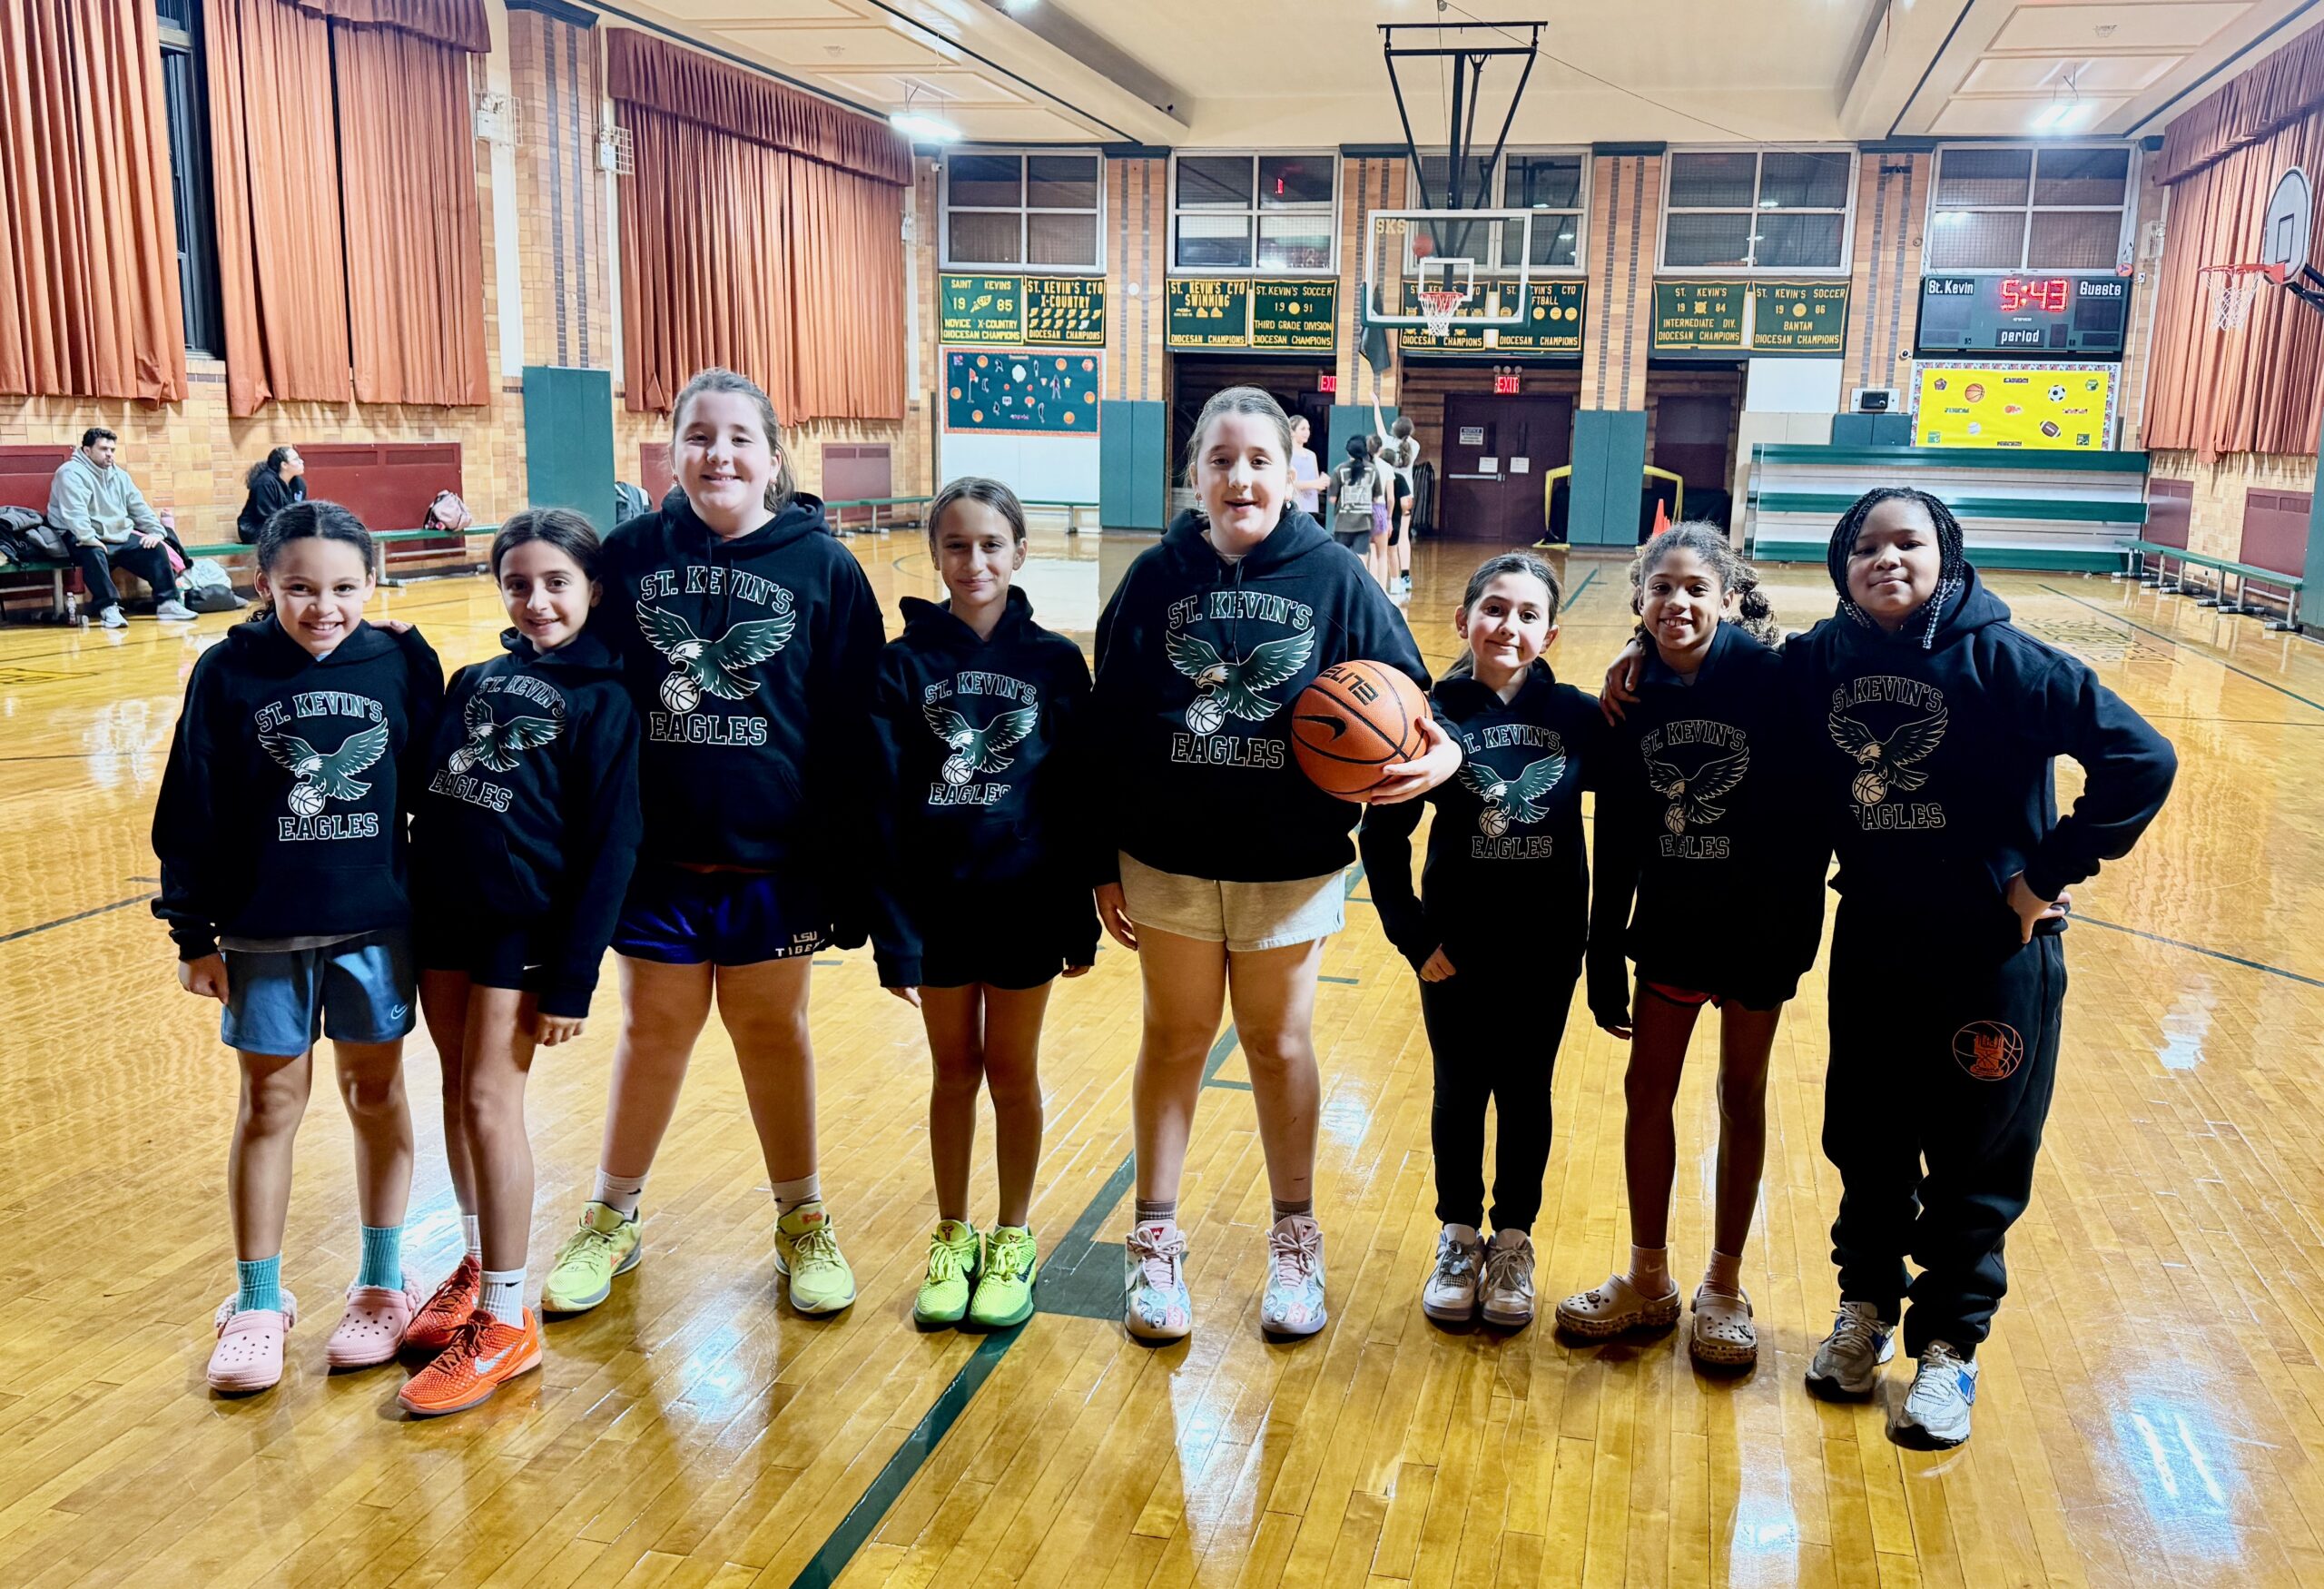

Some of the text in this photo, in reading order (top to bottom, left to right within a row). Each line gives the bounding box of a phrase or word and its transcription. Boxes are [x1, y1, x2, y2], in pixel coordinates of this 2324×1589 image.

[1375, 218, 1406, 234] SKS
[950, 279, 1012, 291] SAINT KEVINS
[1028, 281, 1103, 294] ST. KEVIN'S CYO
[1170, 281, 1245, 295] ST. KEVIN'S CYO
[1302, 286, 1332, 296] SOCCER
[1410, 284, 1419, 294] ST
[1506, 285, 1516, 295] ST.
[1561, 285, 1576, 295] CYO
[1675, 287, 1728, 297] ST. KEVIN'S
[2080, 281, 2122, 296] Guests
[1040, 294, 1089, 309] X-COUNTRY
[1185, 294, 1230, 307] SWIMMING
[1531, 296, 1559, 305] FTBALL
[1756, 289, 1846, 300] ST. KEVIN'S SOCCER
[2001, 279, 2069, 311] 5:43
[953, 297, 966, 311] 19
[997, 299, 1013, 311] 85
[1275, 301, 1313, 313] 19 91
[1678, 302, 1726, 312] 19 84
[1776, 304, 1784, 314] 19
[945, 319, 1018, 330] NOVICE X-COUNTRY
[1254, 320, 1332, 331] THIRD GRADE DIVISION
[1663, 318, 1736, 329] INTERMEDIATE DIV.
[1783, 321, 1813, 331] BANTAM
[943, 330, 1020, 340] DIOCESAN CHAMPIONS
[1029, 329, 1101, 340] DIOCESAN CHAMPIONS
[1171, 334, 1245, 344] DIOCESAN CHAMPIONS
[1254, 334, 1331, 346] DIOCESAN CHAMPIONS
[1403, 336, 1482, 347] DIOCESAN CHAMPIONS
[1500, 336, 1579, 346] DIOCESAN CHAMPIONS
[1658, 331, 1740, 340] DIOCESAN CHAMPIONS
[1755, 334, 1839, 344] DIOCESAN CHAMPIONS
[2001, 330, 2040, 345] period
[1321, 375, 1337, 392] EXI
[1497, 375, 1519, 392] EXIT
[641, 566, 794, 615] ST. KEVIN'S
[1167, 590, 1314, 631] ST. KEVIN'S
[924, 671, 1038, 706] ST. KEVIN'S
[1319, 666, 1380, 706] ELITE
[477, 675, 566, 719] ST. KEVIN'S
[1853, 676, 1944, 713] KEVIN'S
[255, 690, 383, 733] ST. KEVIN'S
[649, 711, 768, 746] EAGLES
[1462, 724, 1561, 755] T. KEVIN'S
[1640, 719, 1747, 758] ST. KEVIN'S
[1170, 732, 1285, 769] EAGLES
[428, 768, 514, 813] EAGLES
[278, 812, 379, 842] EAGLES
[1471, 835, 1552, 860] EAGLES
[1659, 834, 1730, 859] EGLES
[793, 930, 818, 944] LSU
[774, 938, 826, 958] TIGE
